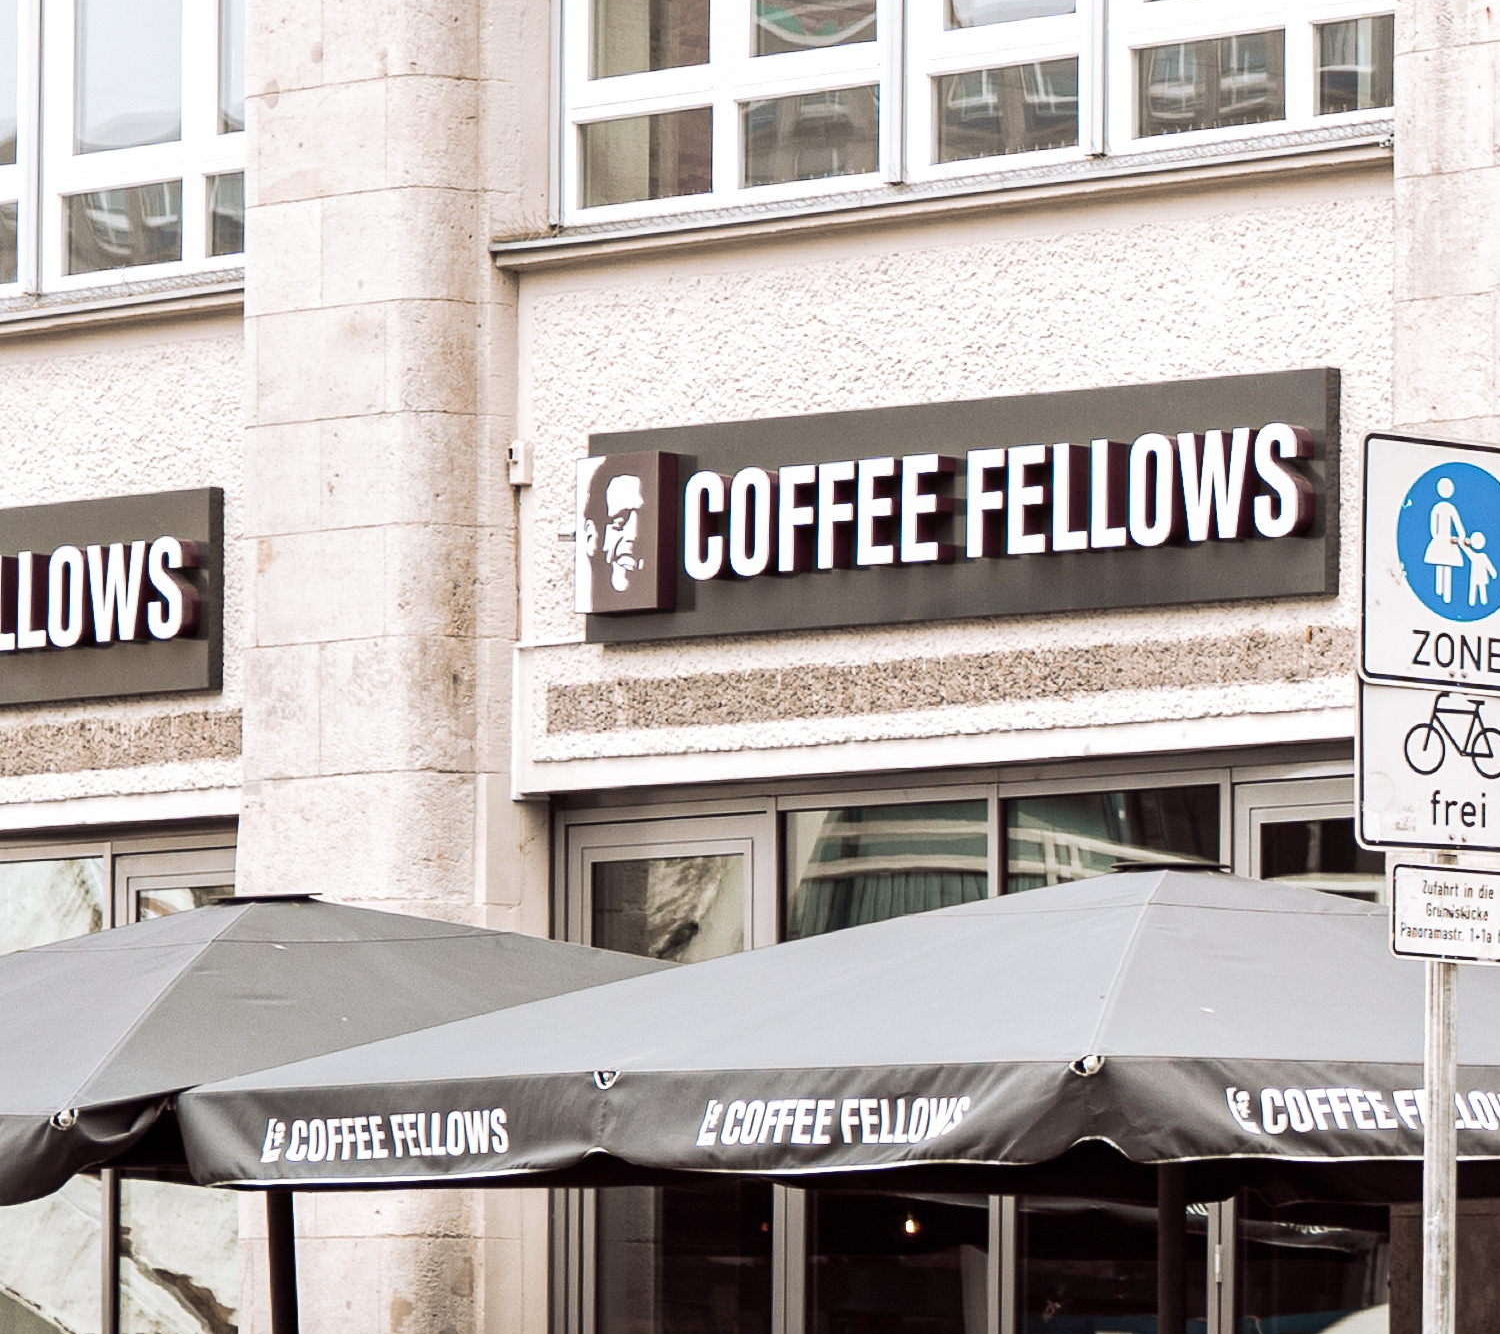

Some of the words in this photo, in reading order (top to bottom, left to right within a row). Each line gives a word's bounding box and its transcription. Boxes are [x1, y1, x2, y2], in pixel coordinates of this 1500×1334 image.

[684, 452, 939, 582] COFFEE
[966, 422, 1299, 559] FELLOWS
[1431, 789, 1487, 828] frei
[1422, 880, 1459, 898] Zufahrt
[1464, 883, 1473, 898] in
[1479, 884, 1494, 899] die
[292, 1113, 387, 1161] COFFEE
[390, 1107, 510, 1158] FELLOWS
[719, 1099, 836, 1147] COFFEE
[841, 1096, 972, 1145] FELLOWS
[1260, 1087, 1399, 1134] COFFEE
